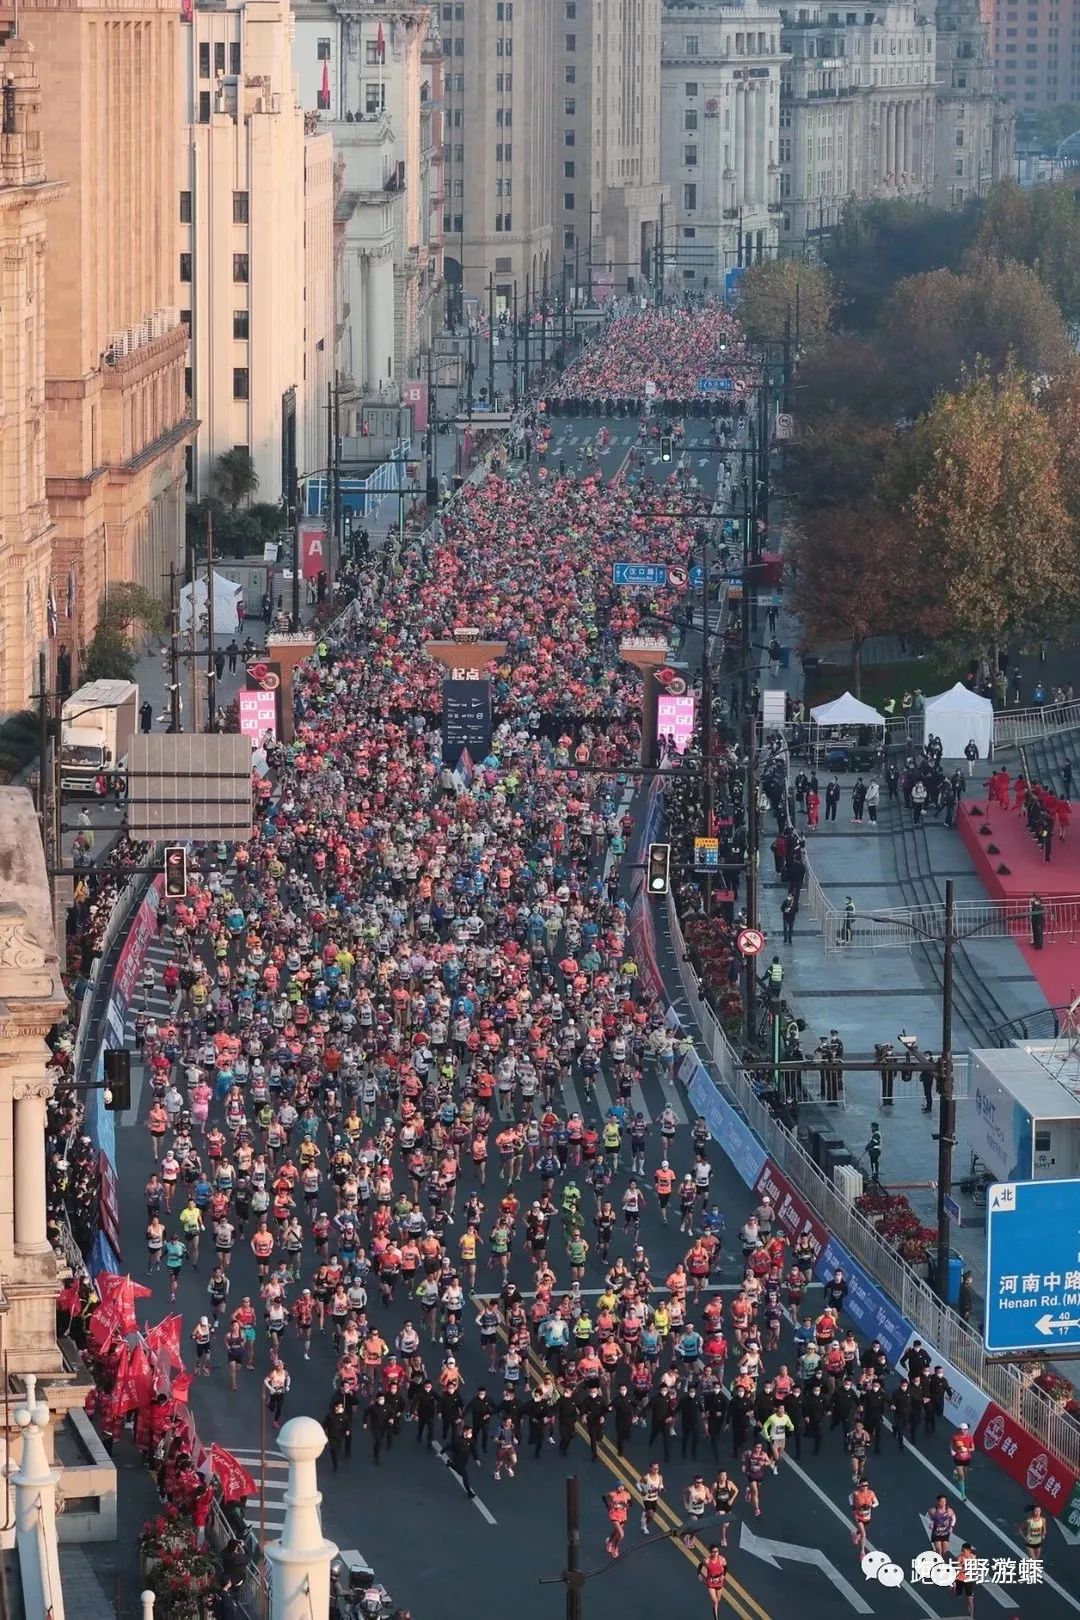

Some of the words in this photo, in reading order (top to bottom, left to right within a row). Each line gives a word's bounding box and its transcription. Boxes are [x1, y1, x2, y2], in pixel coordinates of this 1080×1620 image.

[308, 540, 323, 556] A
[452, 667, 480, 681] 起点
[1001, 1189, 1013, 1201] 北
[999, 1271, 1080, 1294] 河南中路
[999, 1298, 1037, 1309] Henan
[1041, 1296, 1060, 1306] Rd.
[1059, 1312, 1070, 1320] 40
